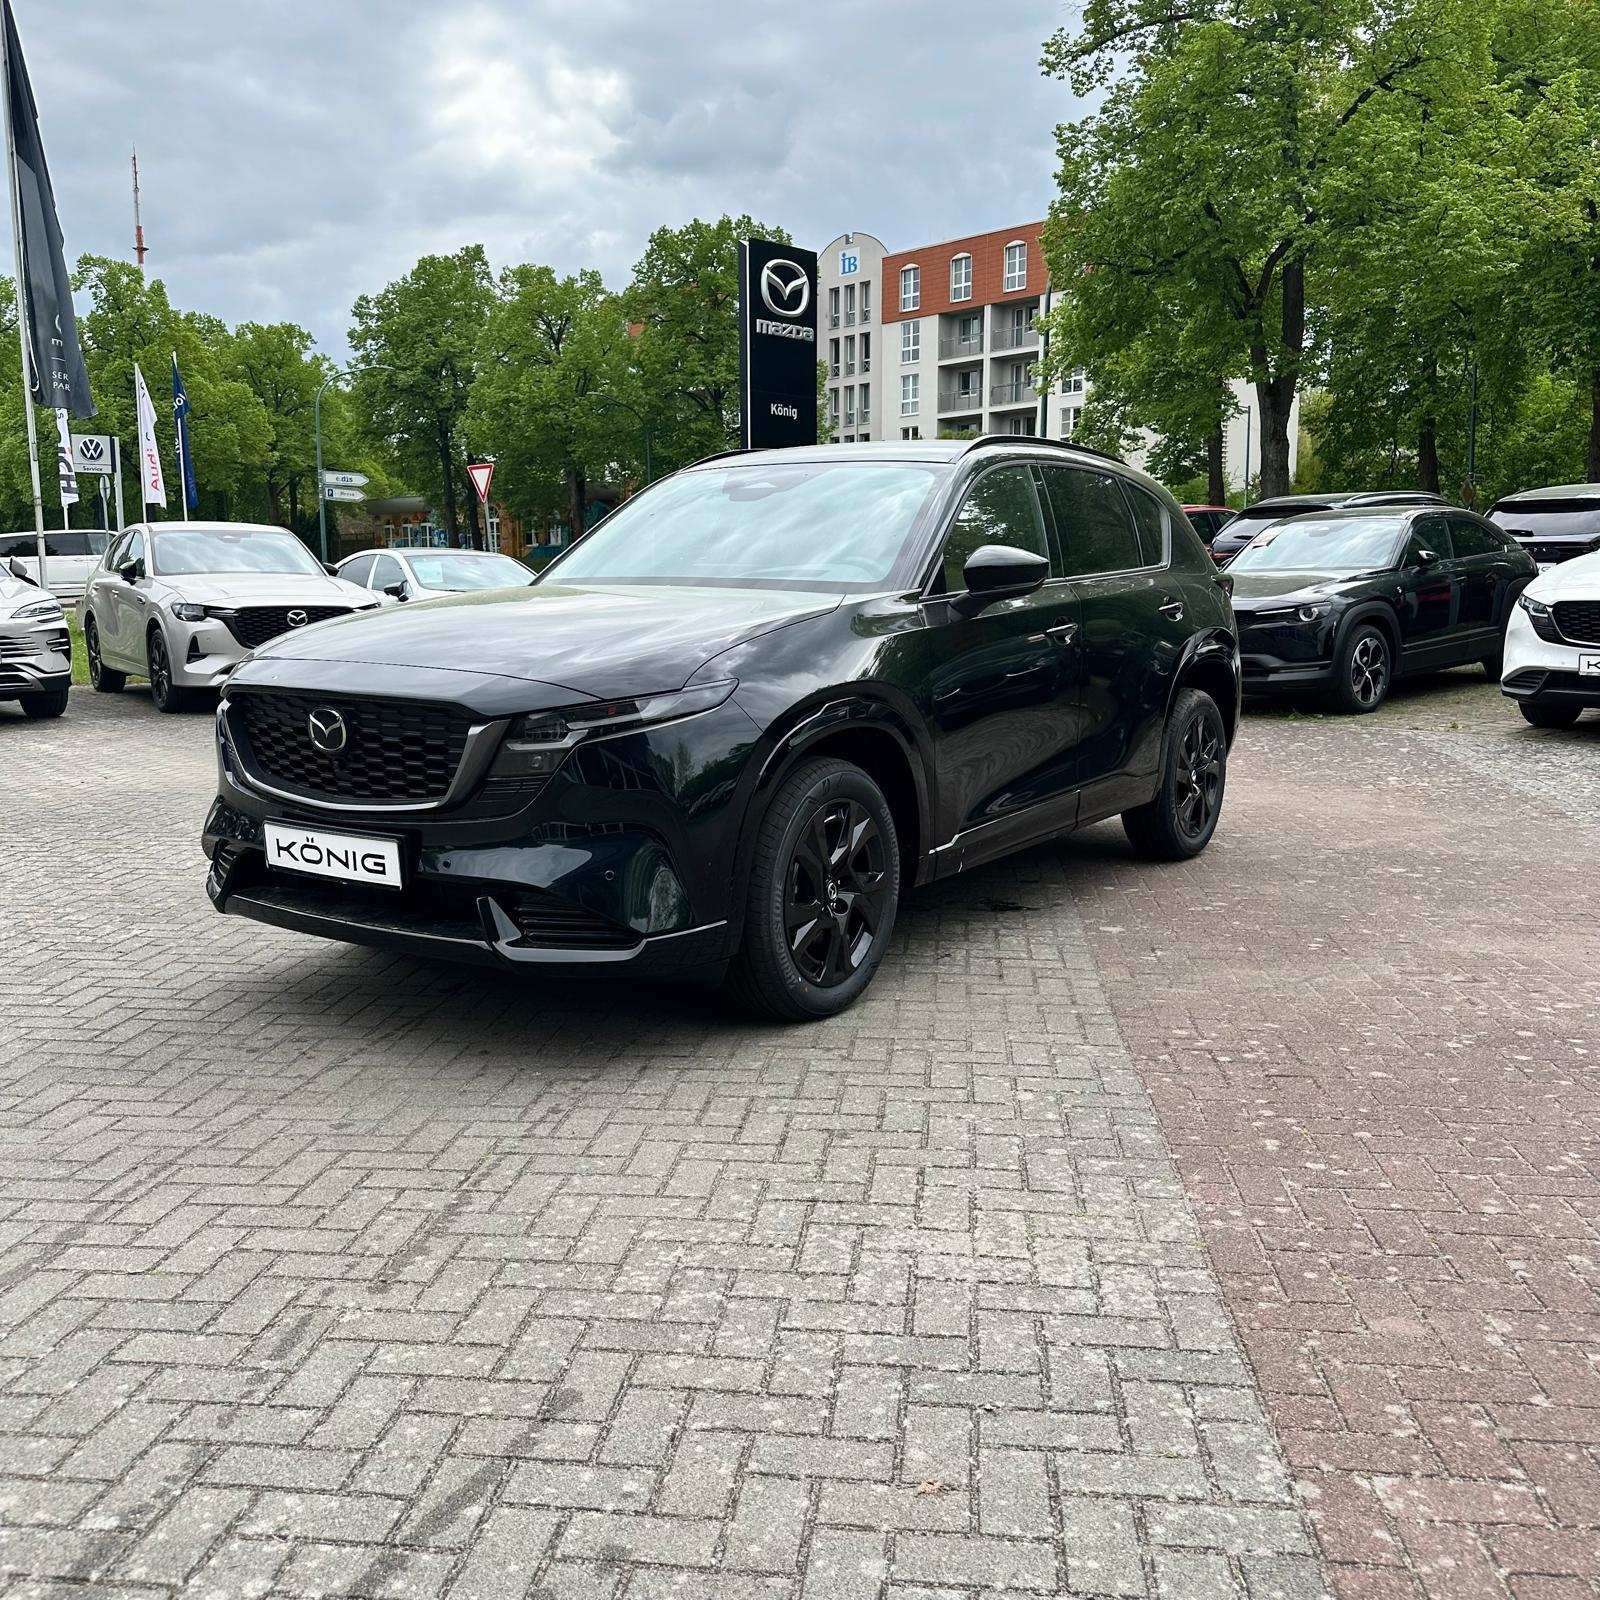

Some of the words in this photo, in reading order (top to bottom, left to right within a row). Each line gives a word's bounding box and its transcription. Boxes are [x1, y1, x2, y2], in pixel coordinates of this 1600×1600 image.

[770, 402, 798, 420] König
[146, 448, 160, 490] Audi
[276, 836, 387, 875] KÖNIG
